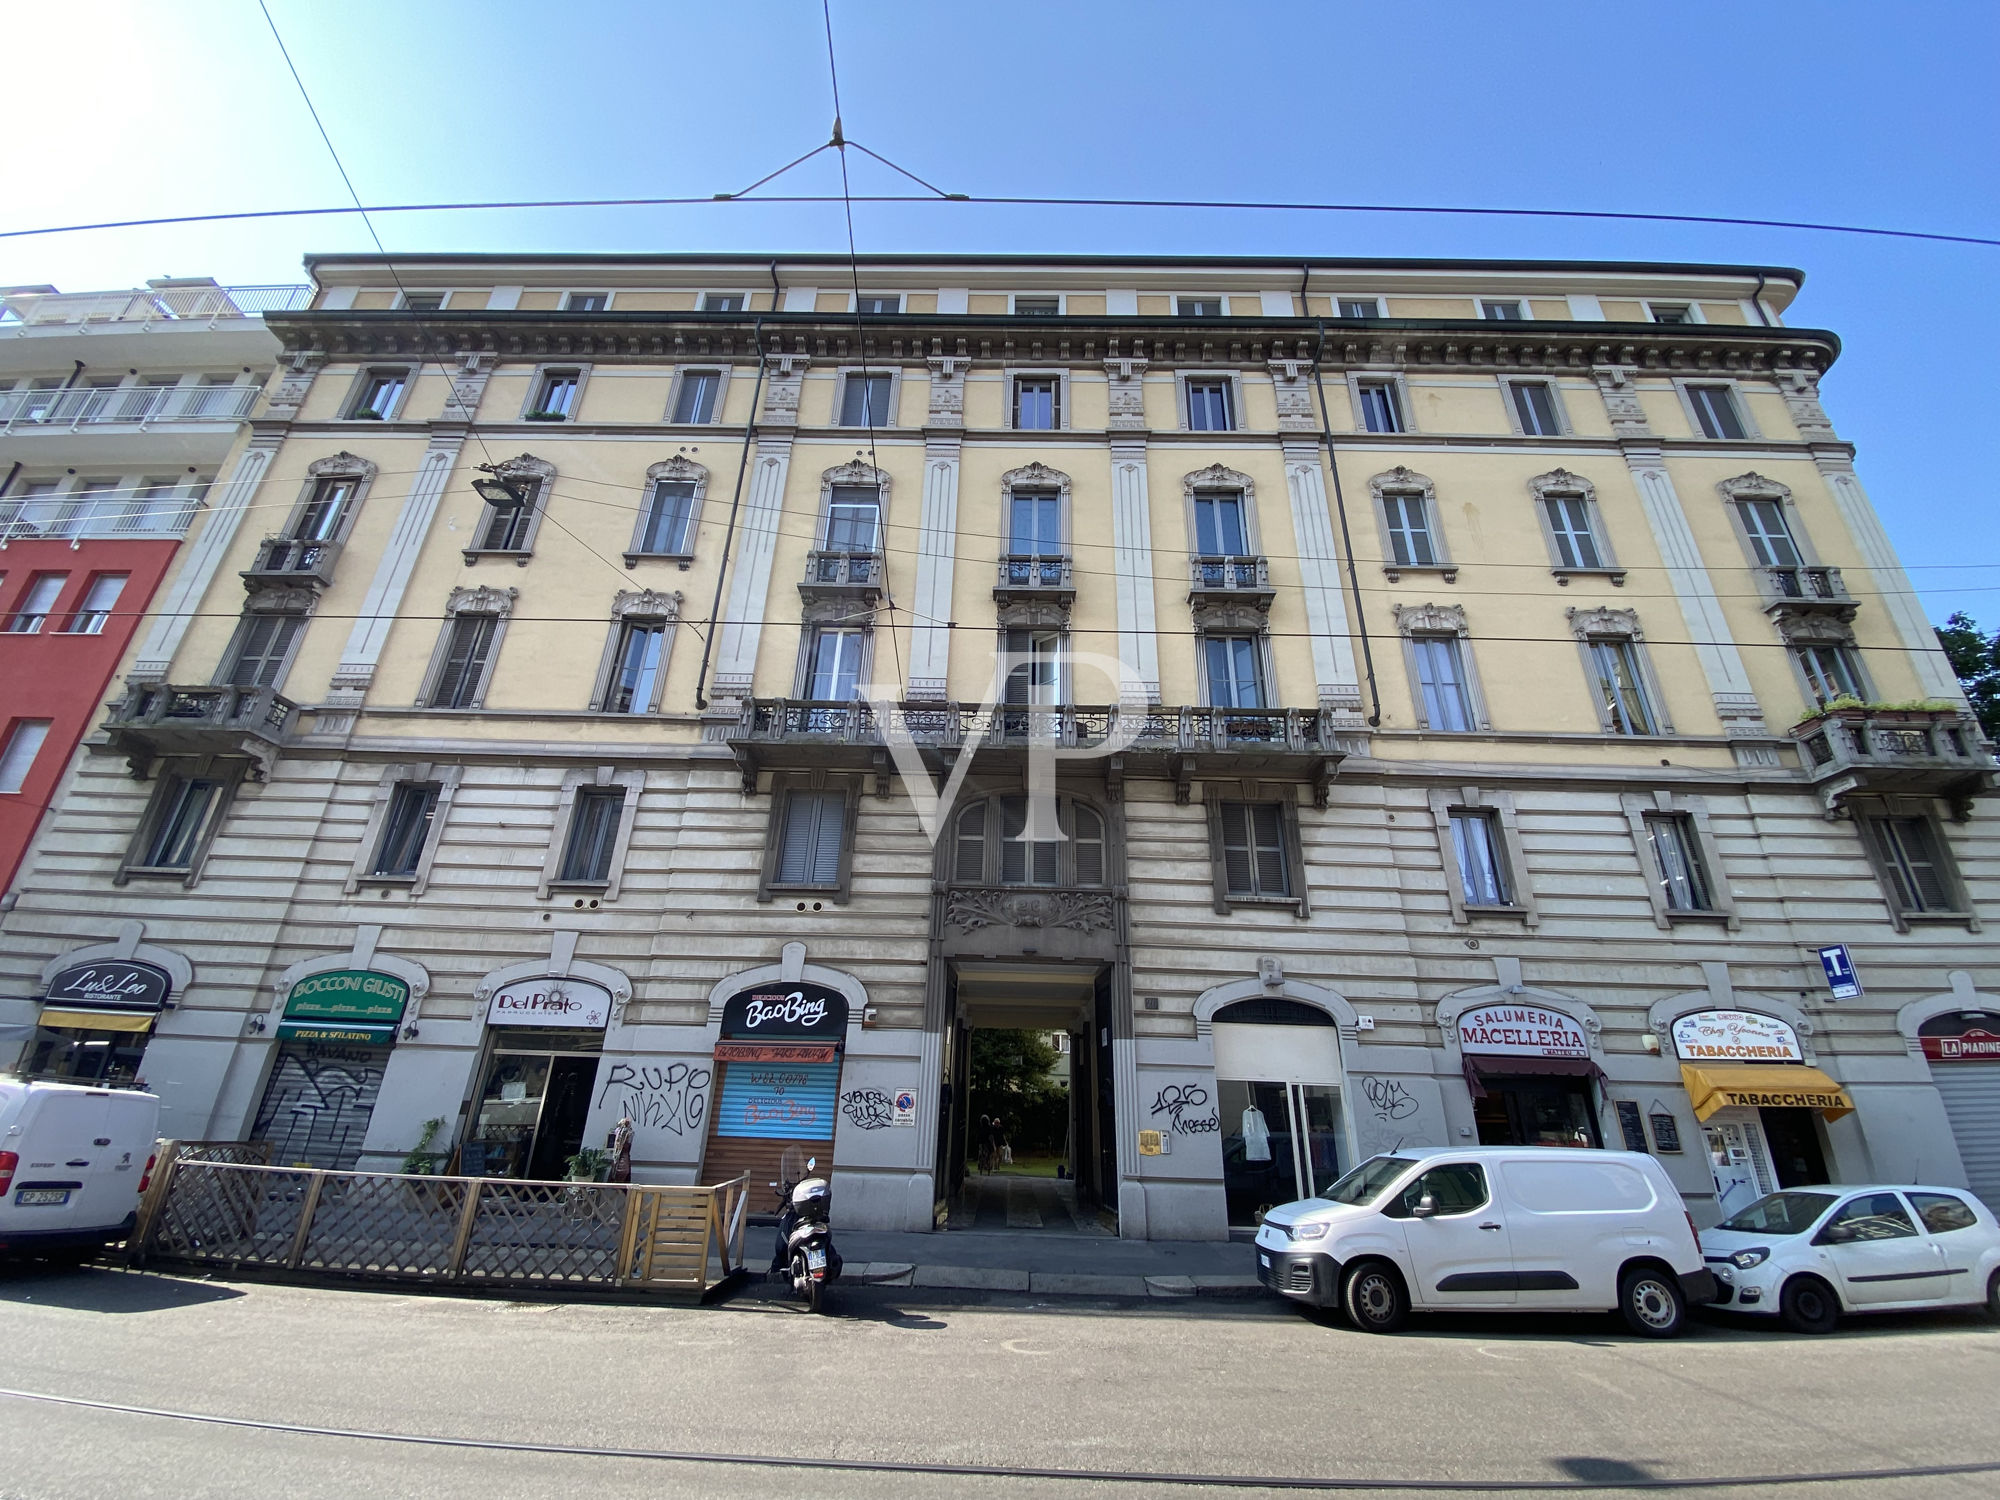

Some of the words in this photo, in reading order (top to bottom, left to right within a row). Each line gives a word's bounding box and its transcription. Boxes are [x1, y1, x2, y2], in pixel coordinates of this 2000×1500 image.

[1822, 949, 1842, 976] T
[64, 970, 147, 994] Lu&Leo
[294, 976, 362, 998] BOCCONI
[363, 978, 405, 1003] GIUSTI
[498, 995, 529, 1010] Del
[531, 994, 582, 1014] Prato
[746, 992, 828, 1028] BaoBing
[1475, 1010, 1563, 1029] SALUMERIA
[295, 1030, 319, 1038] PIZZA
[328, 1031, 371, 1040] SFILATINO
[1461, 1027, 1584, 1047] MACELLERIA
[1685, 1045, 1793, 1057] TABACCHERIA
[1944, 1042, 1958, 1054] LA
[1727, 1093, 1845, 1107] TABACCHERIA
